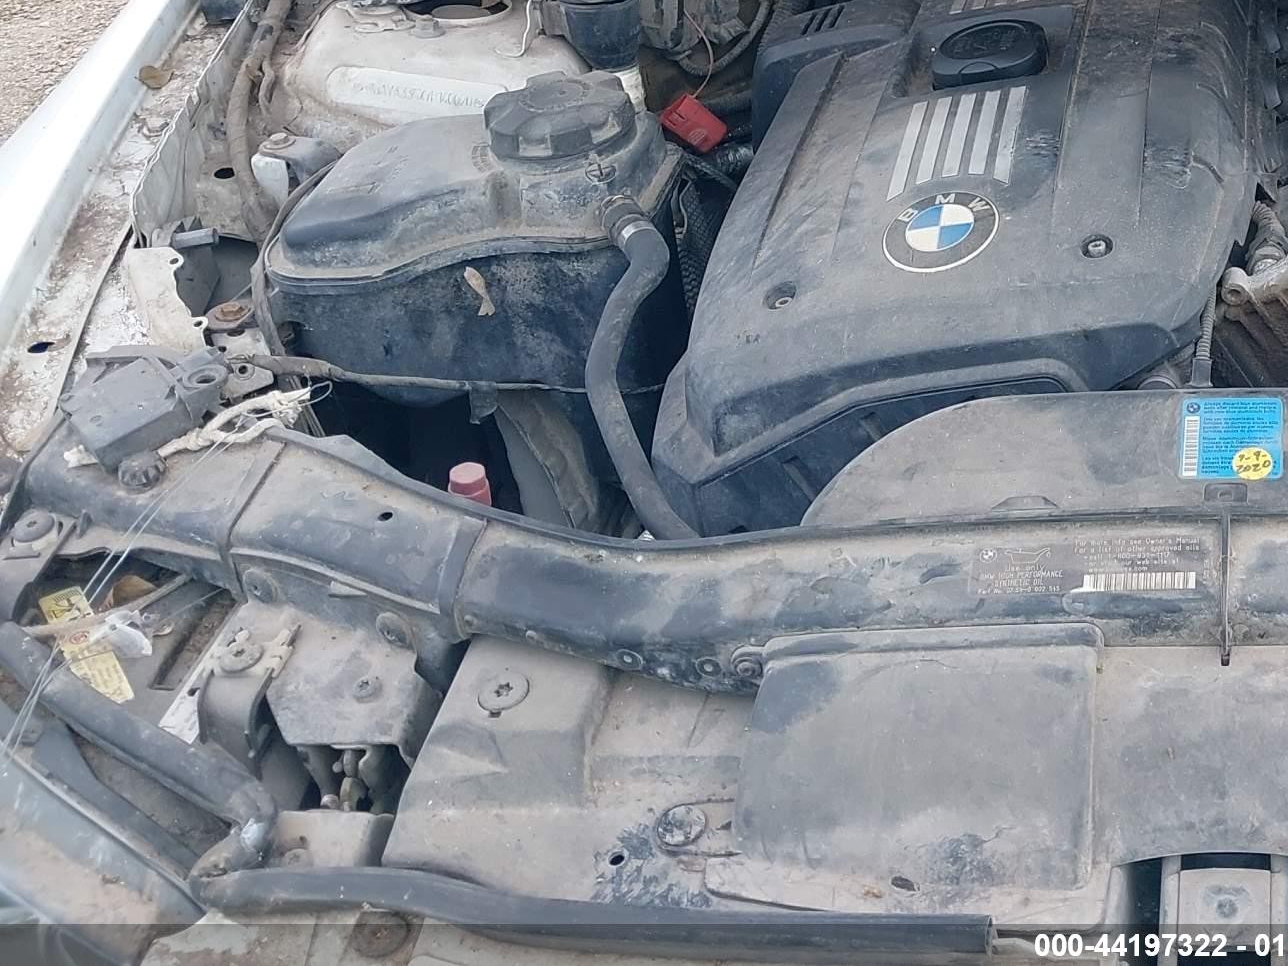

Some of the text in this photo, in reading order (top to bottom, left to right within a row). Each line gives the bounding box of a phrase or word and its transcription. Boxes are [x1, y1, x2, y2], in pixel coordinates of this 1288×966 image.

[897, 193, 992, 223] BMW
[1236, 459, 1271, 474] 2020
[1017, 570, 1064, 579] PERFORMANCE
